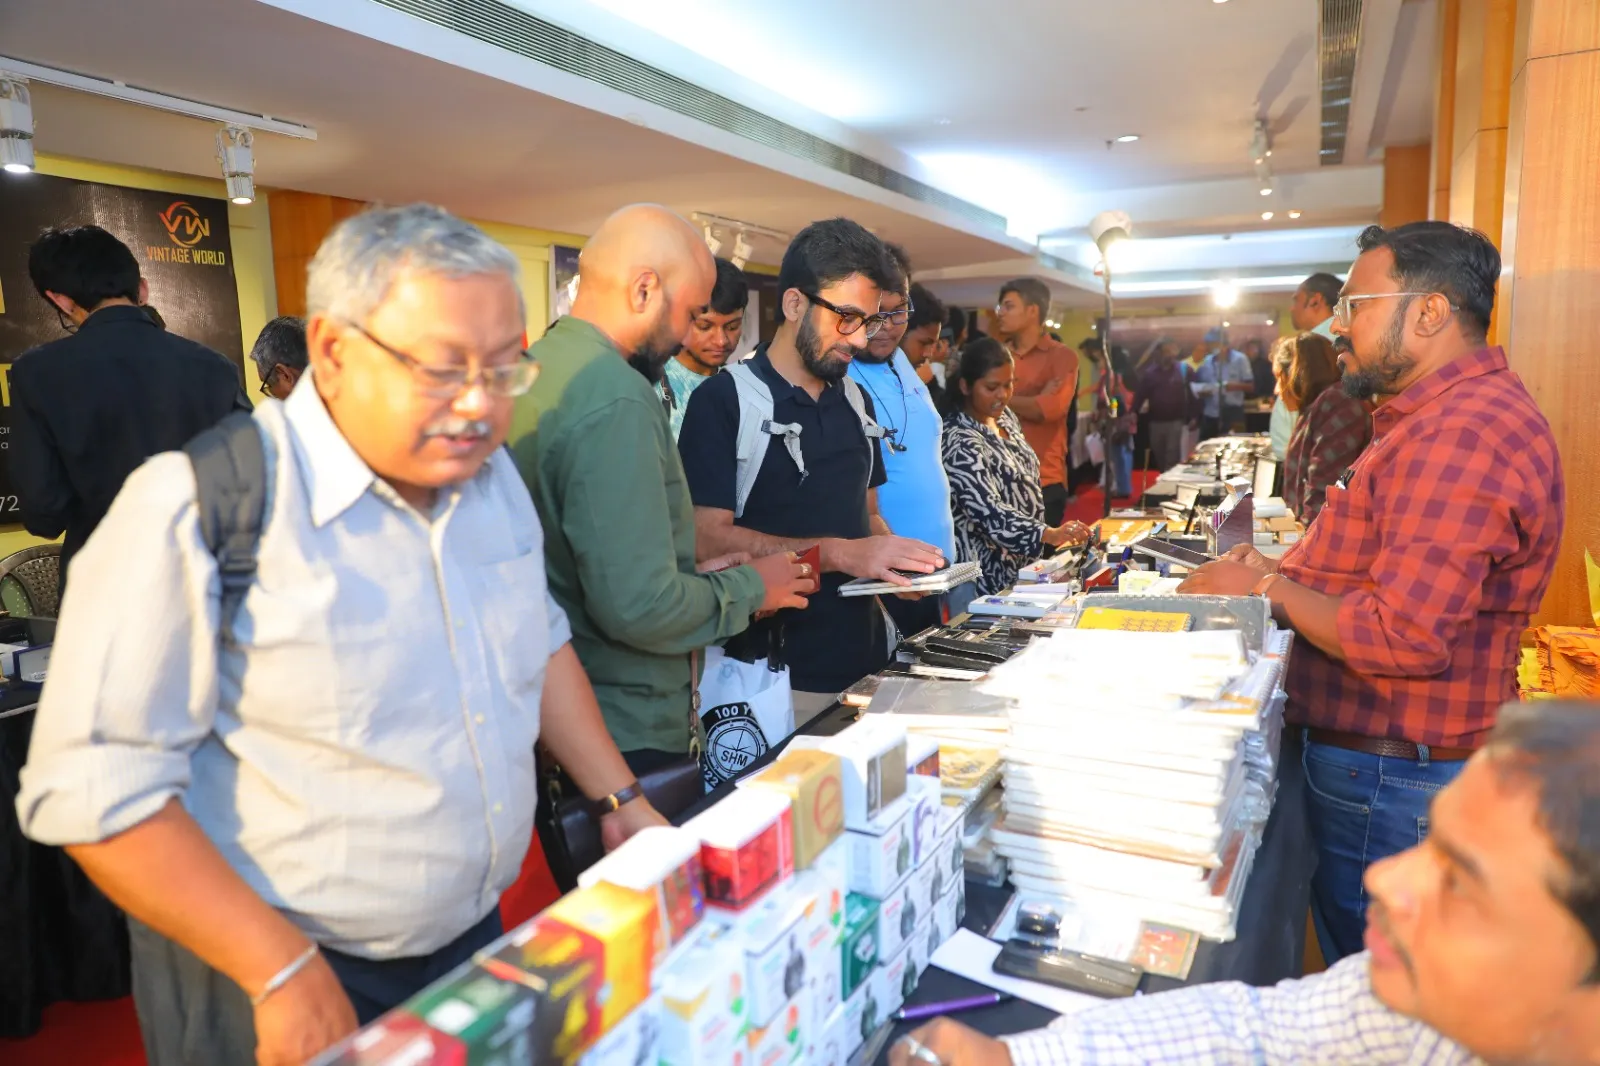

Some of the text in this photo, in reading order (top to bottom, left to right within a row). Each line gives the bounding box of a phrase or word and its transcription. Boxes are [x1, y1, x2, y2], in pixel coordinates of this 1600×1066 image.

[159, 212, 210, 237] VW
[147, 246, 225, 265] VINTAGE WORLD
[715, 705, 739, 719] 100
[720, 751, 748, 766] SHM
